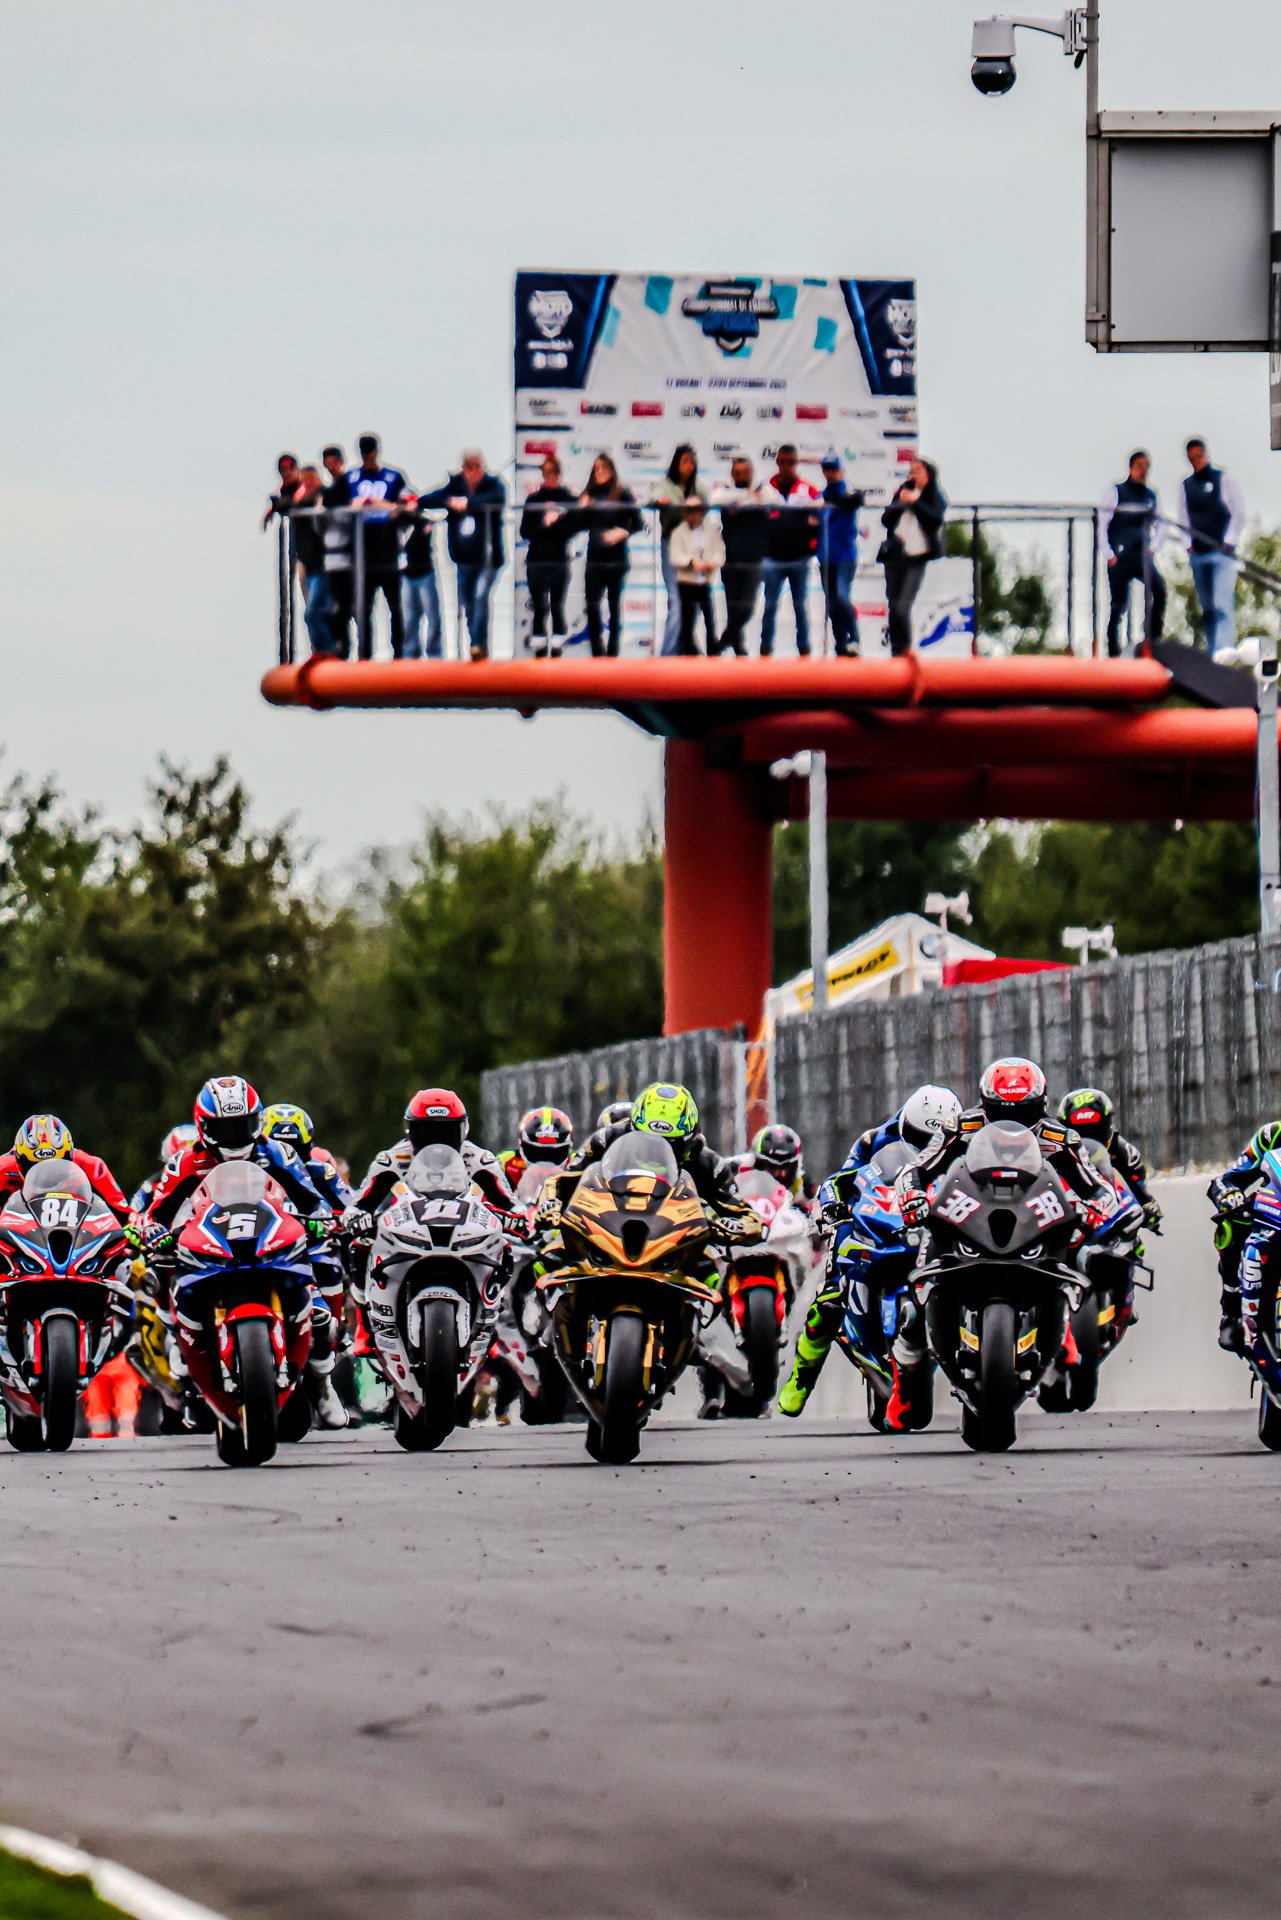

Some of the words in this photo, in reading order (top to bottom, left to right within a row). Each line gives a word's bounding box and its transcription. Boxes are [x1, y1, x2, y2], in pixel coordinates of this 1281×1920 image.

[224, 1103, 243, 1111] Arai
[653, 1121, 671, 1130] Arai
[39, 1149, 55, 1157] Arai
[40, 1198, 79, 1228] 84
[479, 1208, 492, 1229] AVA6
[936, 1189, 982, 1224] 38
[1025, 1189, 1065, 1229] 38
[226, 1213, 258, 1240] 5
